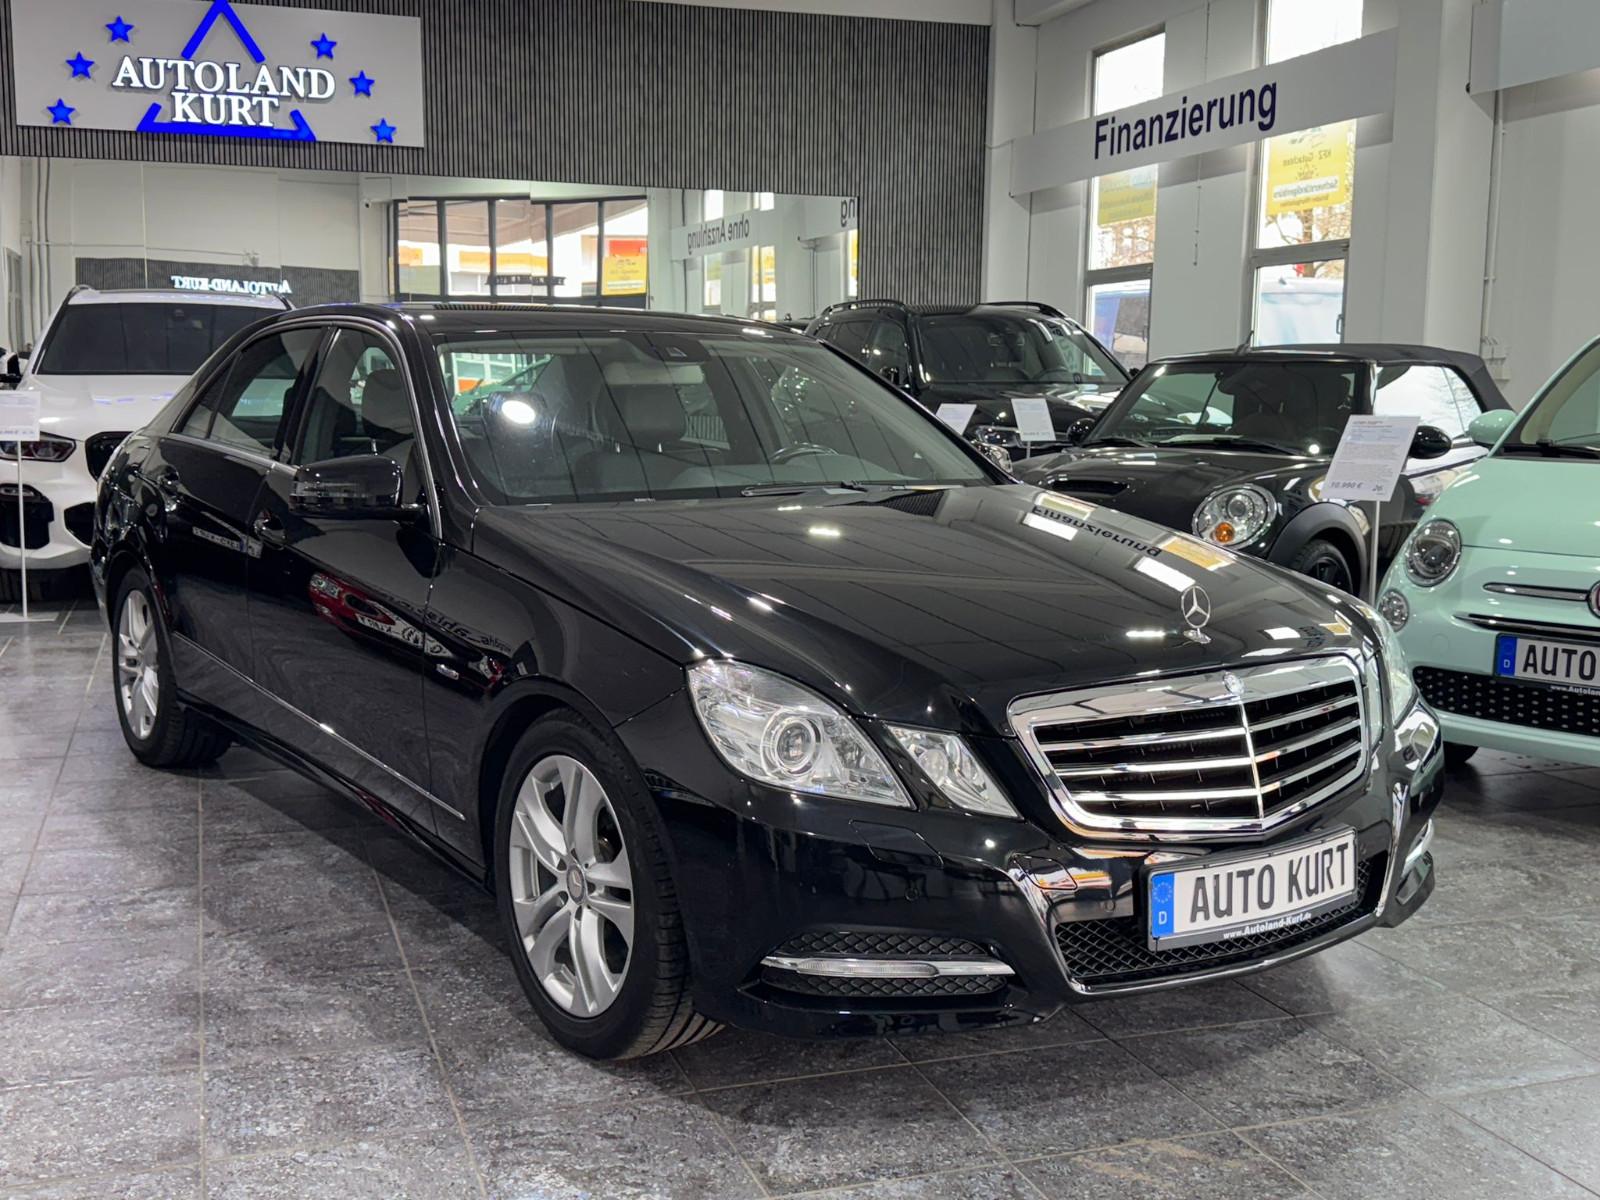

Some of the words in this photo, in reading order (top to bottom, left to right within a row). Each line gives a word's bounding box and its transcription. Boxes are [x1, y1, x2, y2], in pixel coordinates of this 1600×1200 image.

[112, 56, 336, 100] AUTOLAND
[171, 91, 280, 127] KURT
[1094, 81, 1278, 159] Finanzierung
[1522, 644, 1597, 681] AUTO
[1190, 863, 1275, 924] AUTO
[1288, 842, 1349, 904] KURT
[1158, 910, 1168, 926] D
